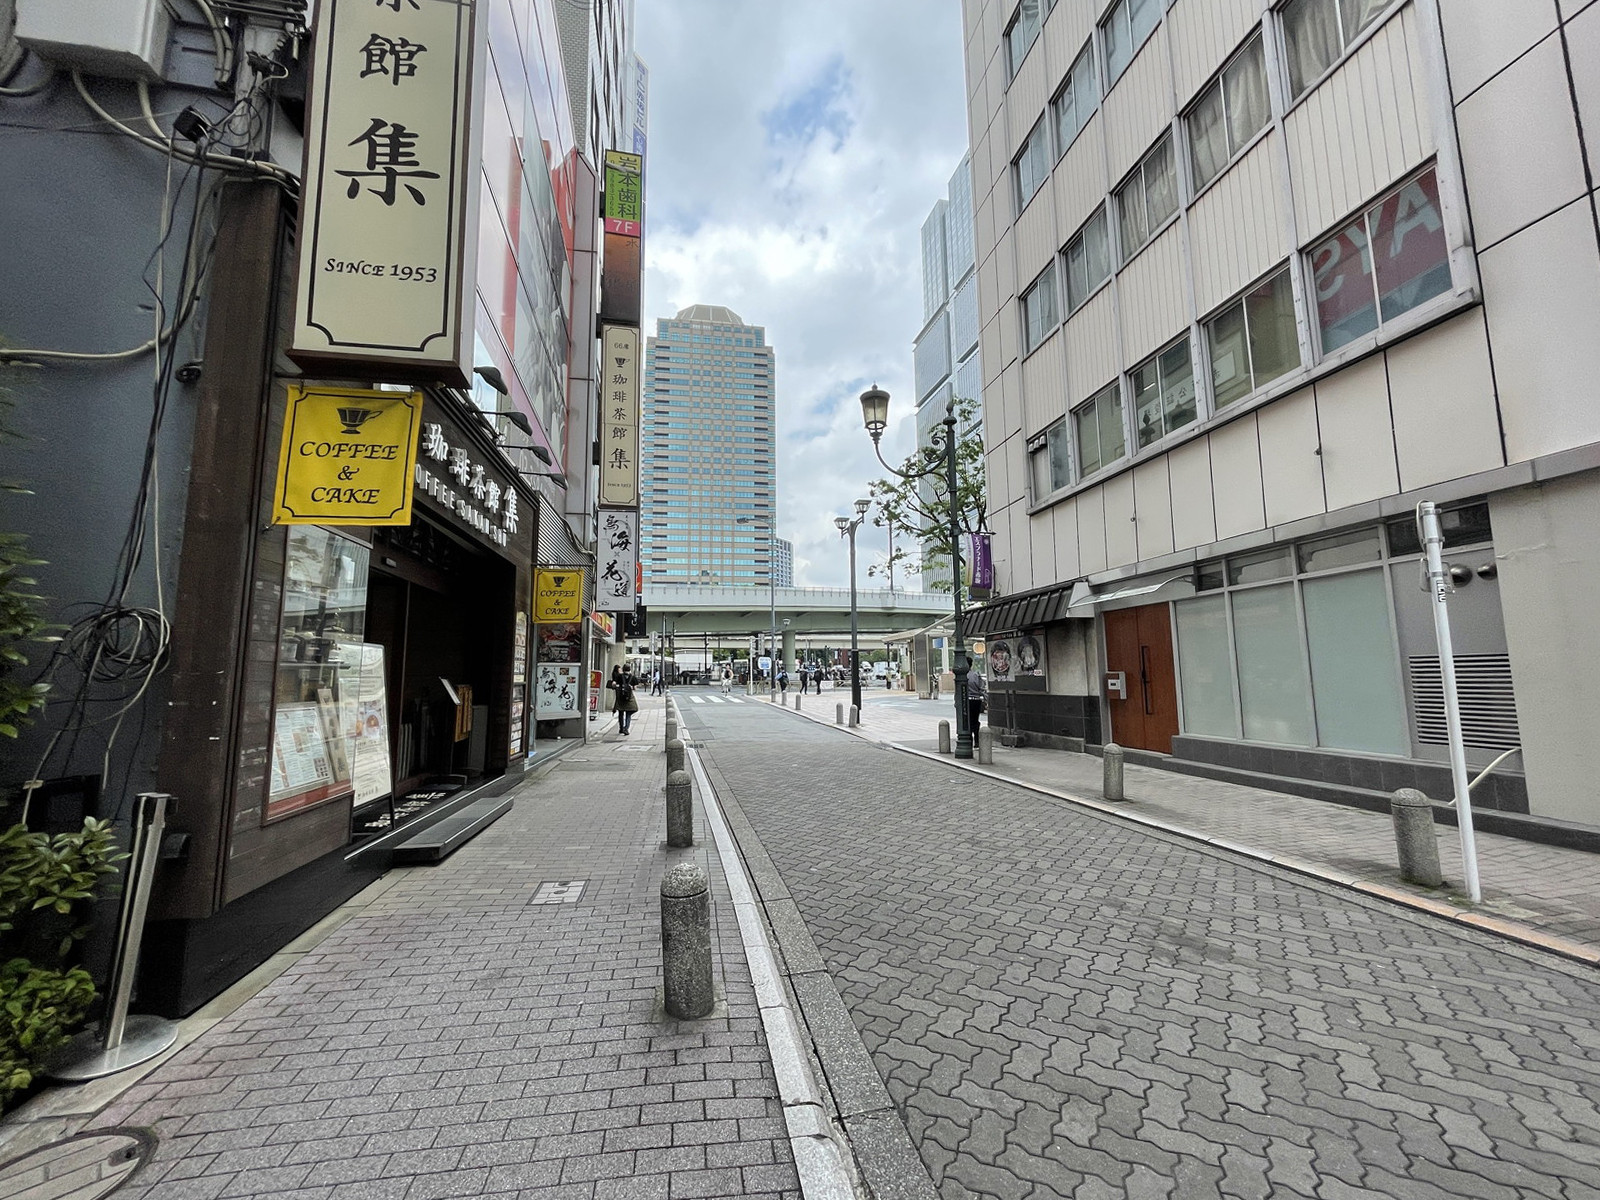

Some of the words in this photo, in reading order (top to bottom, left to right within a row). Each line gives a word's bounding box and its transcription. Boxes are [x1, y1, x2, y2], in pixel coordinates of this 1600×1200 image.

[613, 219, 633, 233] 7F
[324, 258, 385, 277] SINCE
[389, 264, 438, 283] 1953
[299, 441, 399, 460] COFFEE
[337, 465, 360, 481] &
[310, 486, 380, 505] CAKE
[415, 463, 456, 510] OFFEE
[540, 590, 576, 598] COFFEE
